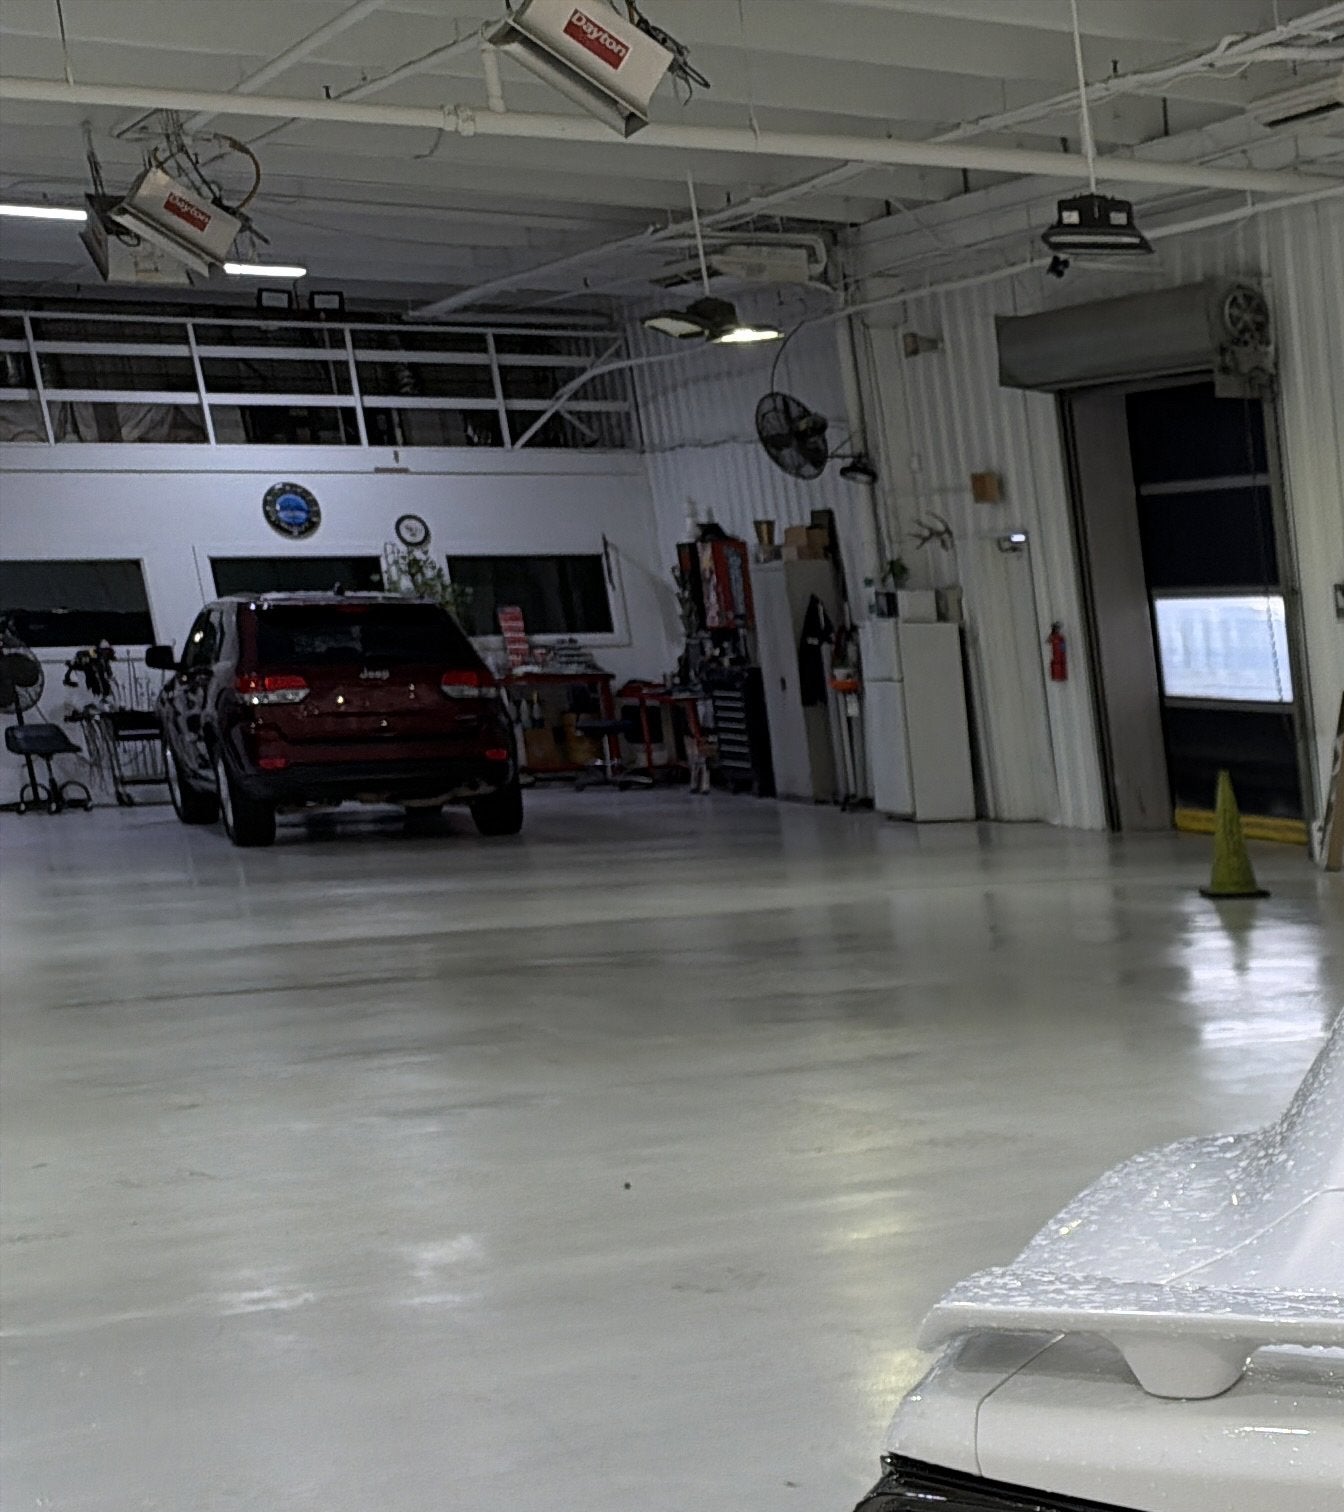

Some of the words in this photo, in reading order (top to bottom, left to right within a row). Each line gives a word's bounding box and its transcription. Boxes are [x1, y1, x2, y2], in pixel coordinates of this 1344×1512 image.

[571, 11, 627, 57] Dayton
[168, 193, 210, 223] Dayton
[359, 665, 390, 681] Jeep
